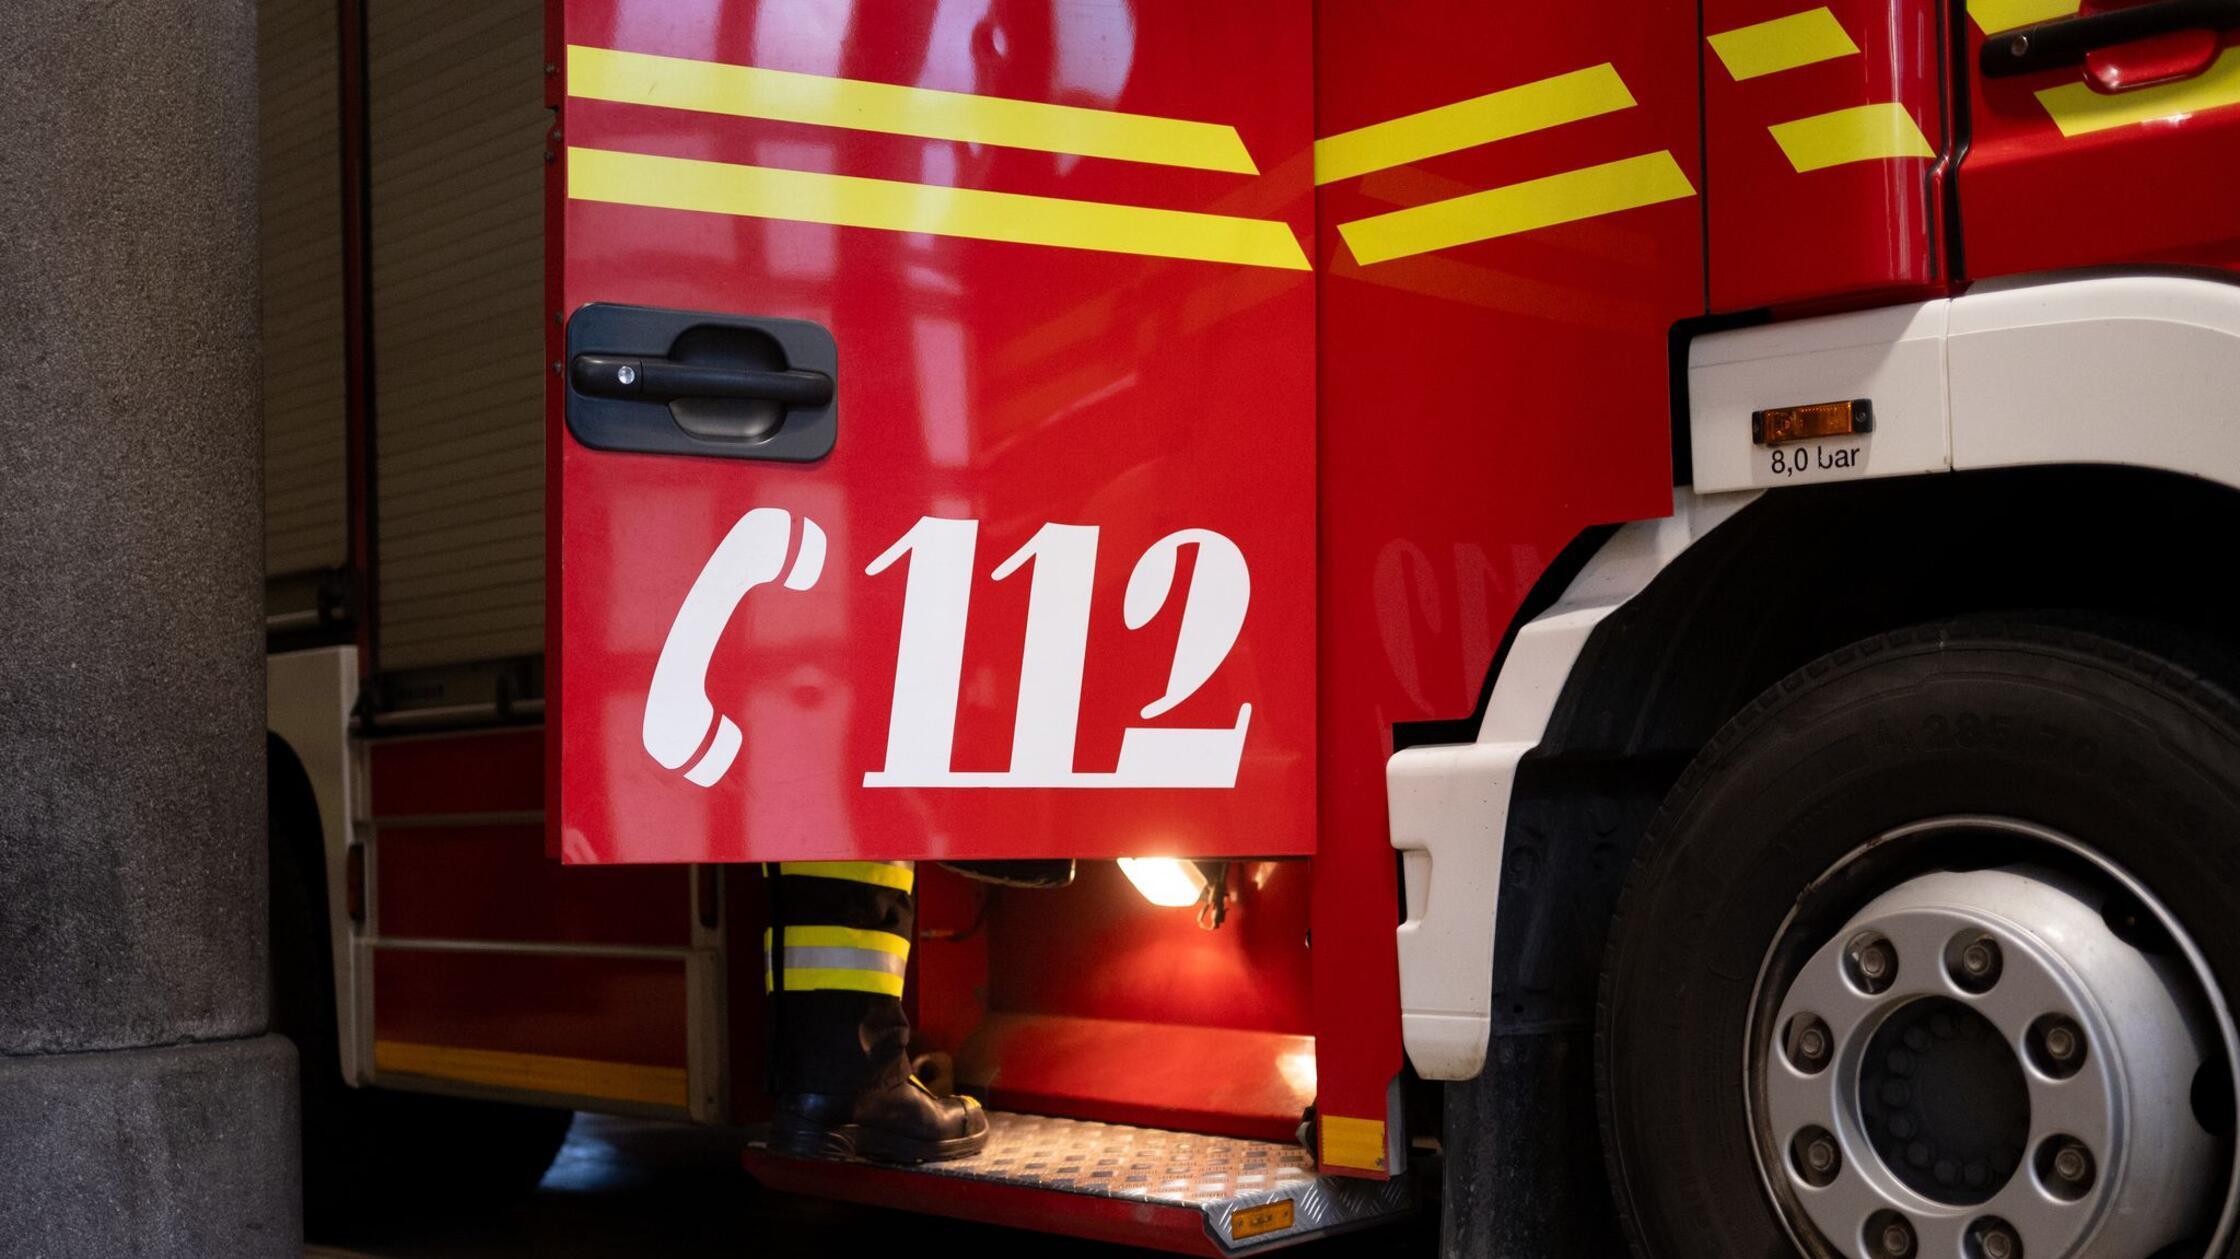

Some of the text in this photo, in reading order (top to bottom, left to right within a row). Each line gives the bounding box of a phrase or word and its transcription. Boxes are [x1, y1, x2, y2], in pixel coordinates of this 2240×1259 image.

[1771, 446, 1860, 476] 8,0 bar
[862, 516, 1252, 788] 112
